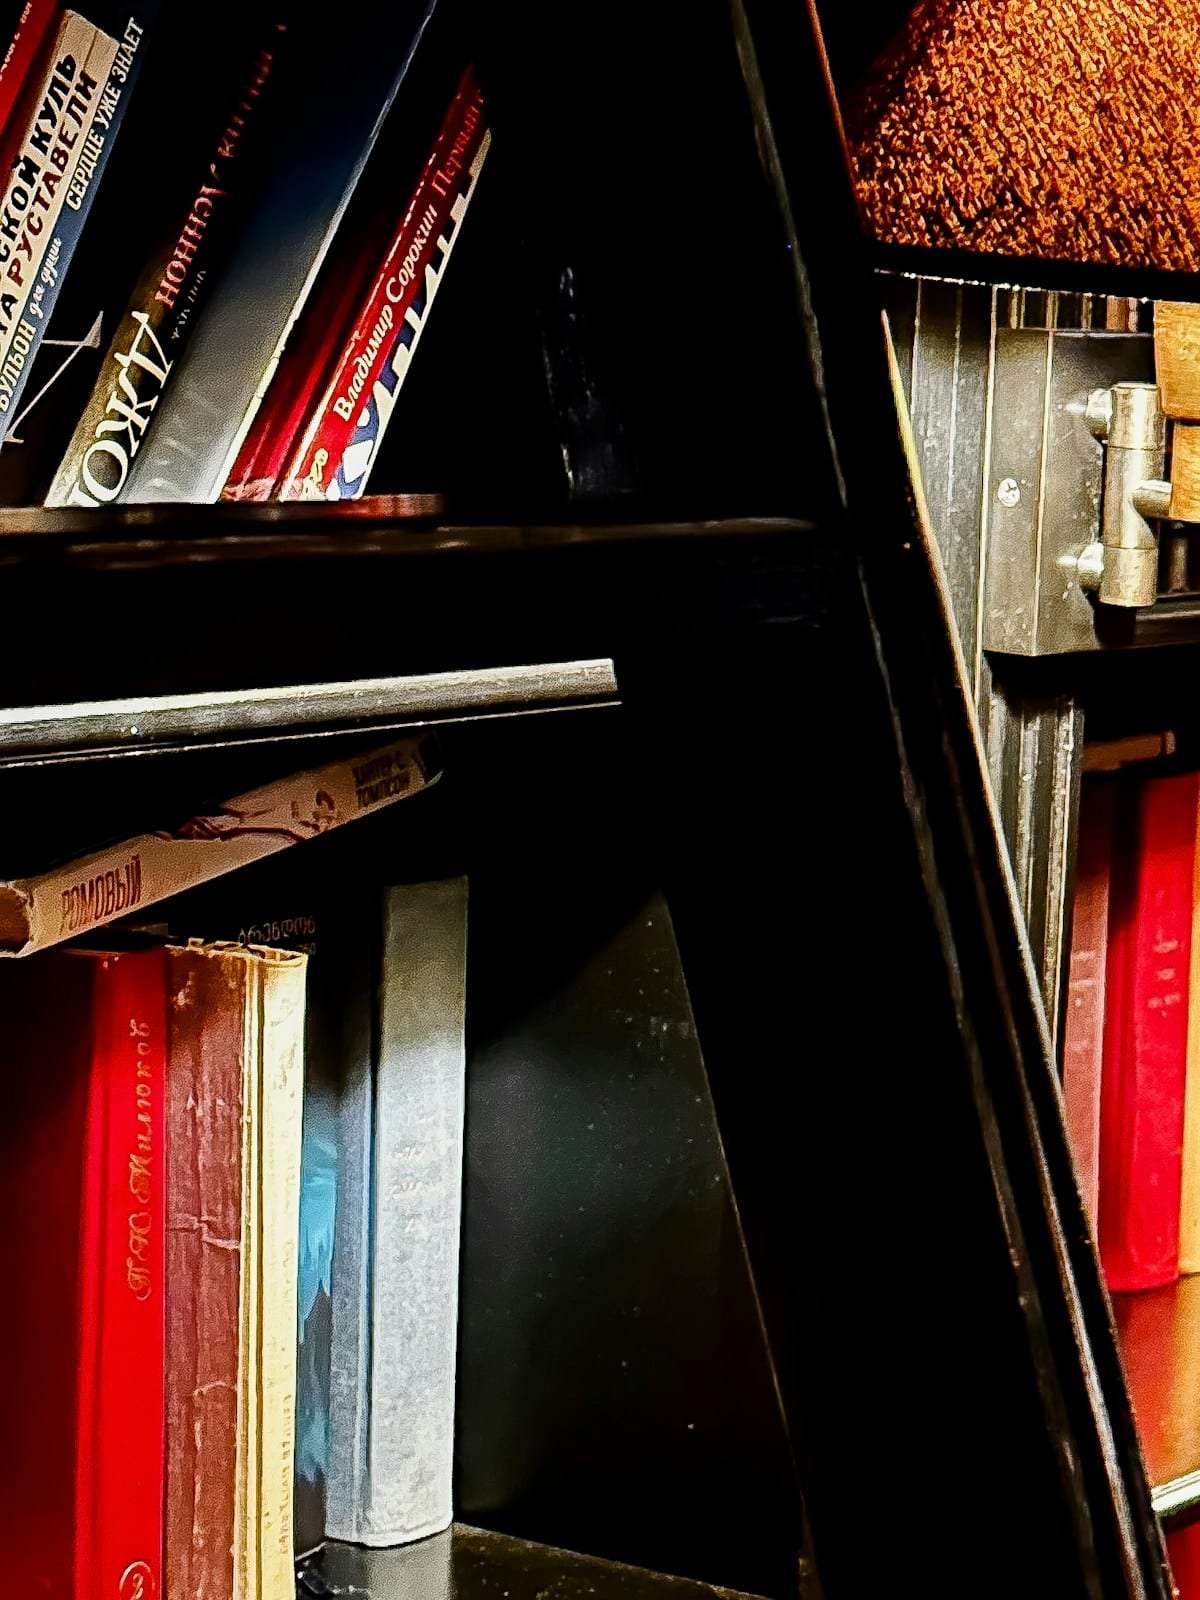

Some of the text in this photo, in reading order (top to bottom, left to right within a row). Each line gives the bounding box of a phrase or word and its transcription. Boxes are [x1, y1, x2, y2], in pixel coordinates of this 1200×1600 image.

[6, 70, 98, 287] РУСТАВЕЛИ
[30, 54, 77, 156] КУЛЬ
[66, 17, 144, 211] СЕРДЦЕ УЖЕ ЗНАЕТ
[333, 303, 394, 422] Владимир
[385, 203, 439, 304] Сорокин
[60, 852, 141, 935] РОМОВЫЙ
